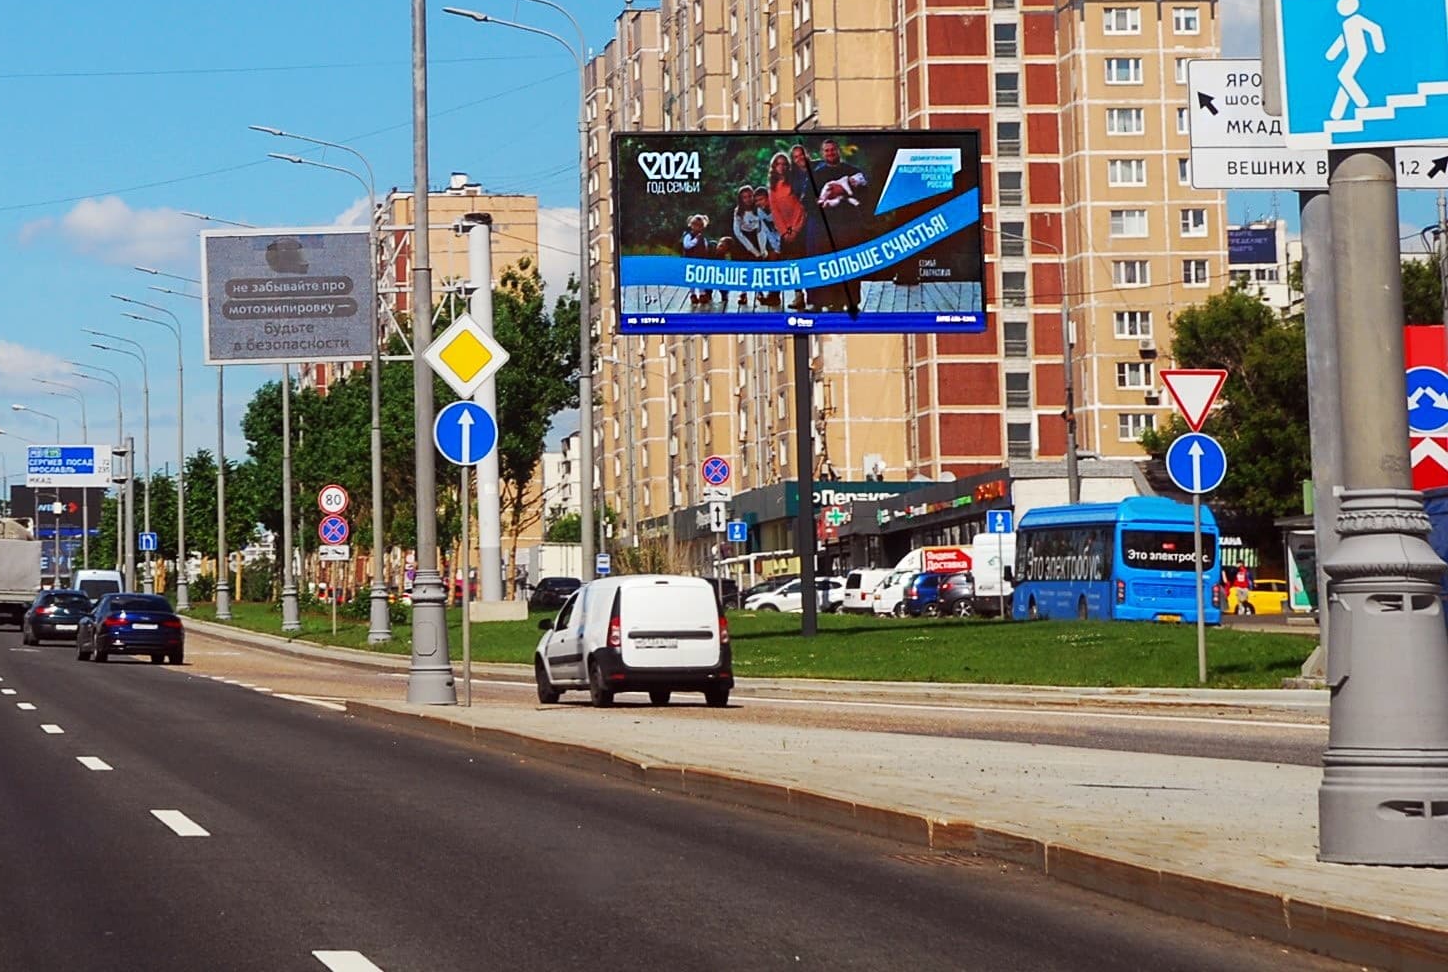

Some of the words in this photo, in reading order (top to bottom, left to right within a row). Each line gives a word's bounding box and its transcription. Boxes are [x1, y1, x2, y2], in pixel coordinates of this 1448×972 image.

[1226, 73, 1262, 87] ЯРО
[1226, 120, 1283, 135] МКАД
[637, 151, 702, 180] 2024
[1227, 161, 1306, 175] ВЕШНИХ
[1399, 160, 1420, 176] 1,2
[646, 181, 666, 195] ГОД
[666, 181, 701, 194] СЕМЬИ
[685, 264, 749, 286] БОЛЬШЕ
[750, 262, 802, 288] ДЕТЕЙ
[818, 246, 883, 280] БОЛЬШЕ
[880, 213, 949, 260] СЧАСТЬЯ!
[232, 283, 249, 293] не
[251, 280, 320, 293] забывайте
[322, 281, 346, 295] про
[228, 302, 335, 315] мотоэкипировку
[264, 321, 315, 336] будьте
[233, 342, 242, 352] в
[246, 338, 351, 352] безопасности
[325, 494, 342, 505] 80
[1027, 546, 1043, 580] Это
[1127, 549, 1147, 560] Это
[1149, 552, 1211, 564] электробс.
